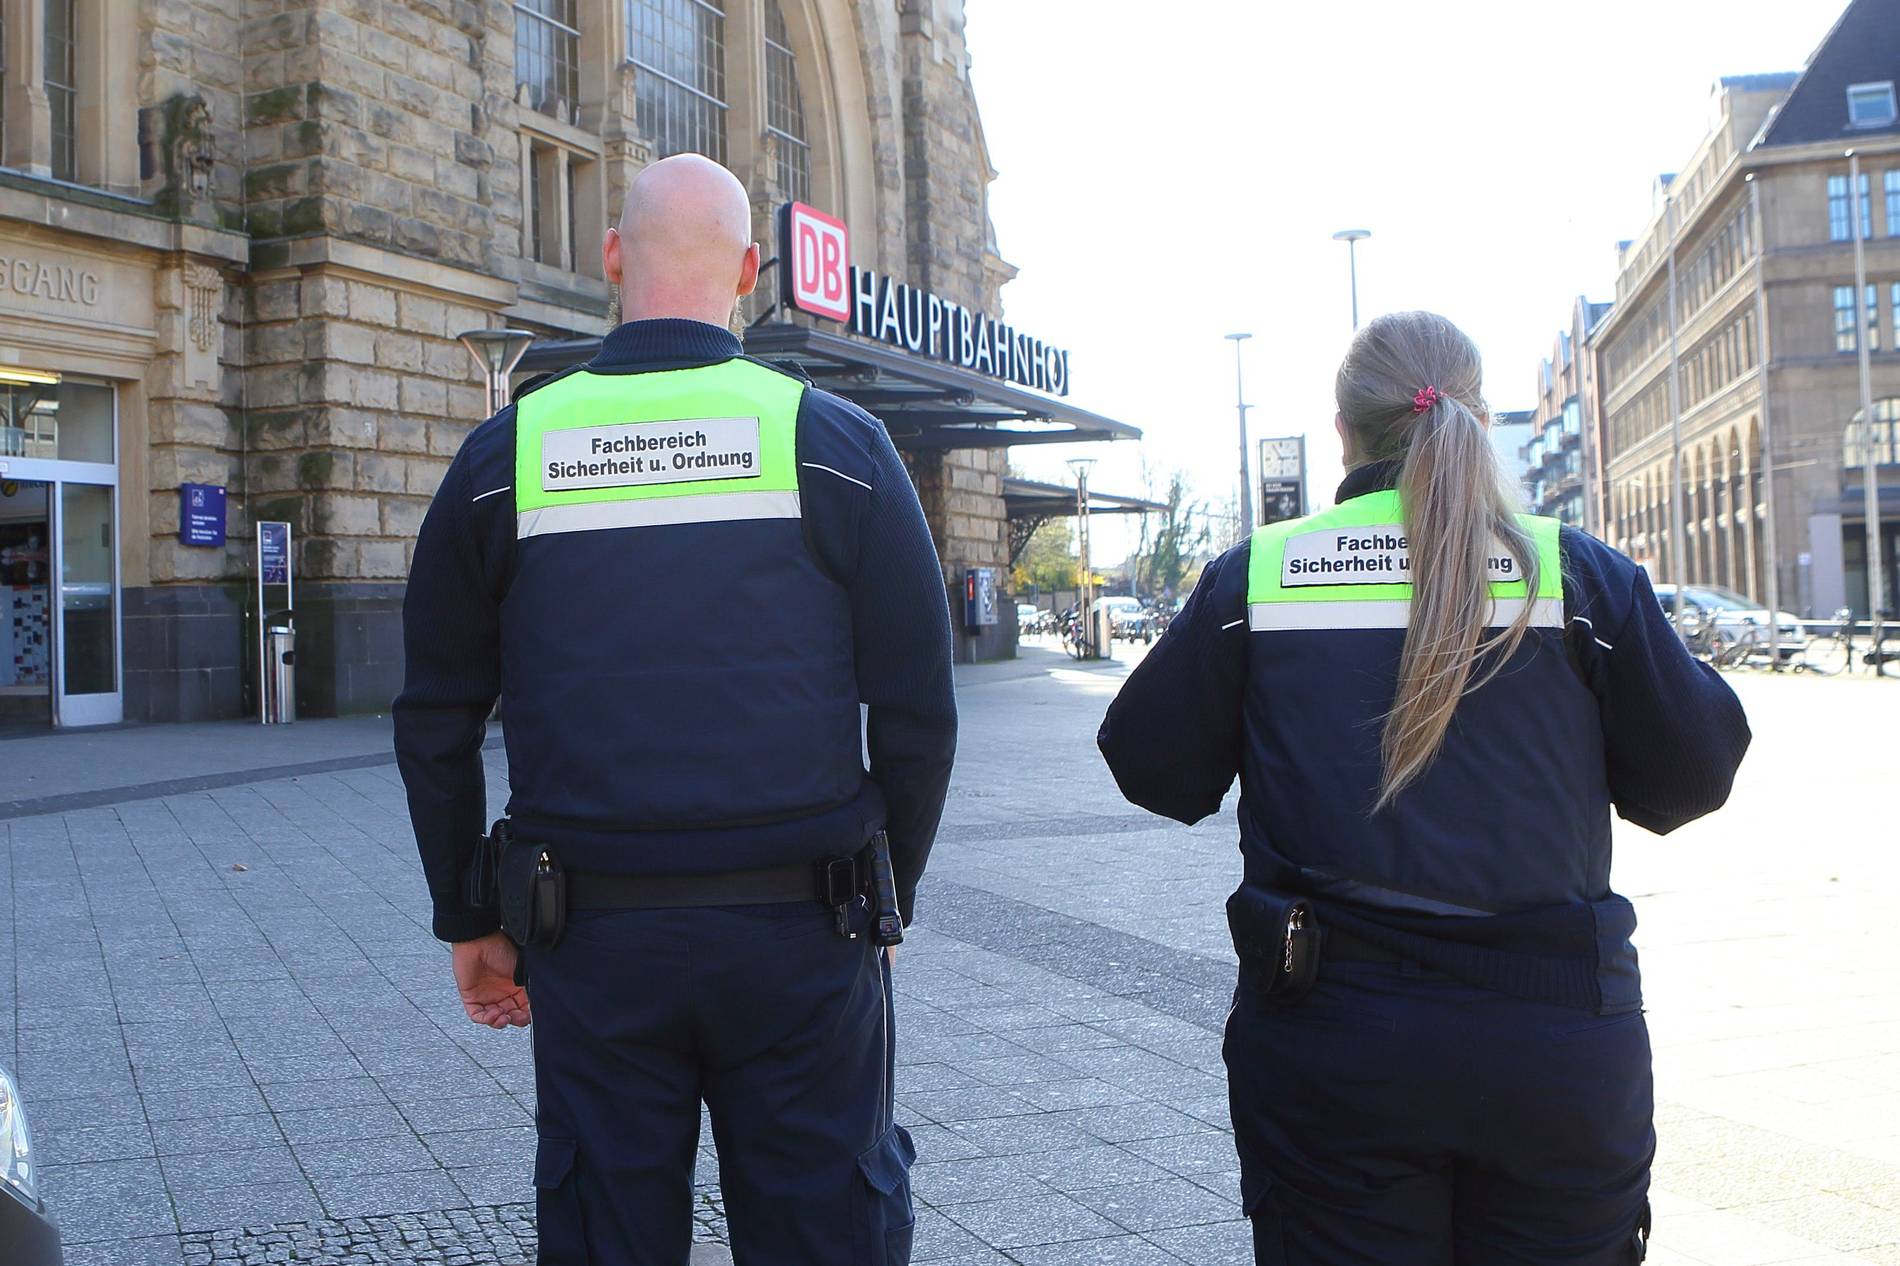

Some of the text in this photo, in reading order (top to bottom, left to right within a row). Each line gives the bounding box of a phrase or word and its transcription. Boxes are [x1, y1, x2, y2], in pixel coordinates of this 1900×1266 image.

[800, 222, 842, 302] DB
[591, 430, 707, 455] Fachbereich
[548, 449, 753, 480] Sicherheit u. Ordnung
[1336, 533, 1409, 552] Fachbe
[1289, 554, 1411, 575] Sicherheit u
